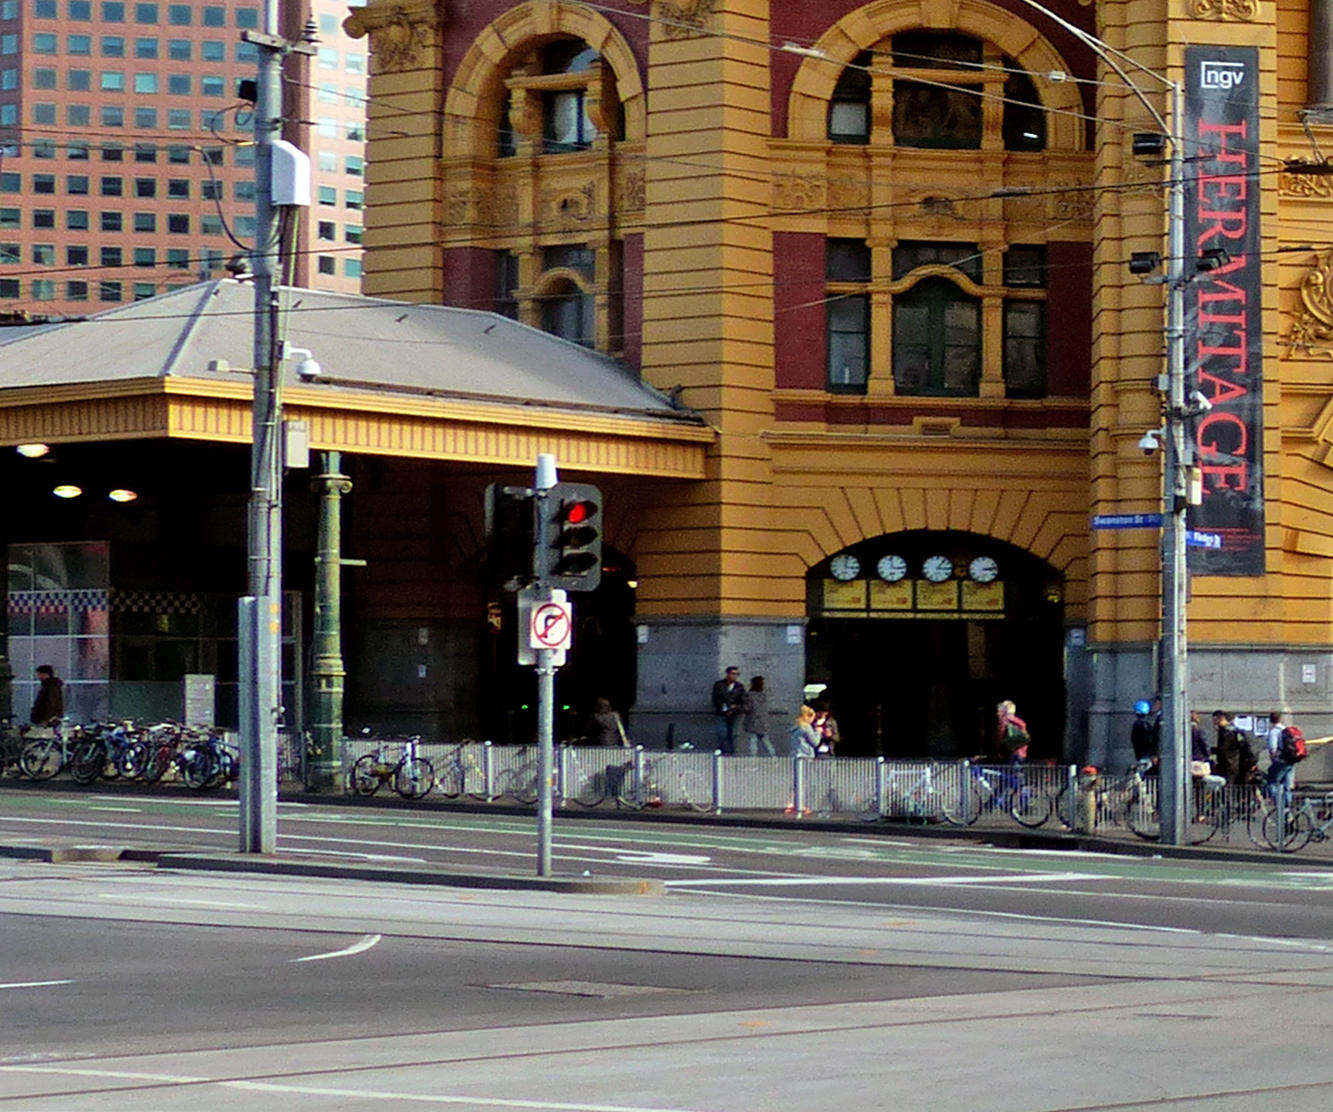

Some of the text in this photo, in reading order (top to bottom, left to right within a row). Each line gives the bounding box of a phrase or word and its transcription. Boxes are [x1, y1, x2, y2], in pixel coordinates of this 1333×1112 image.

[1204, 67, 1245, 90] ngv
[1196, 119, 1249, 494] HERMITAGE
[1093, 515, 1133, 526] Swanston
